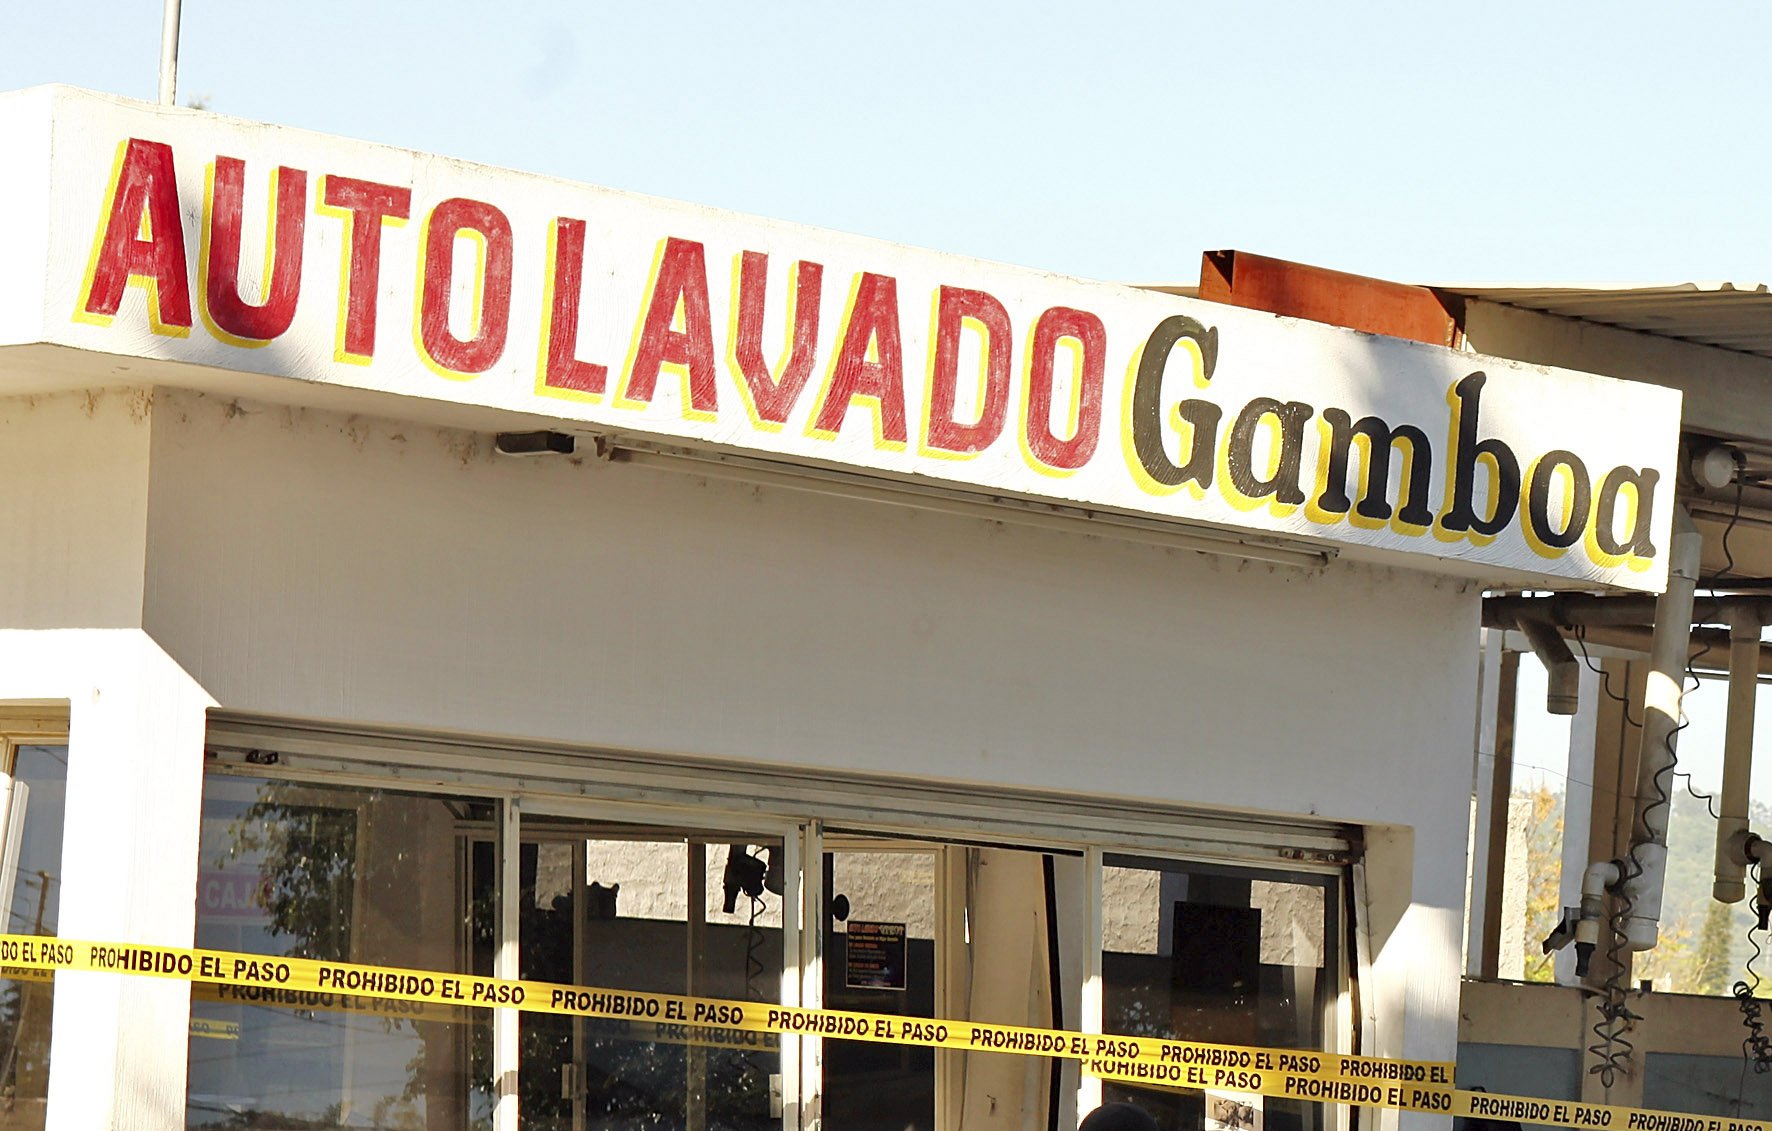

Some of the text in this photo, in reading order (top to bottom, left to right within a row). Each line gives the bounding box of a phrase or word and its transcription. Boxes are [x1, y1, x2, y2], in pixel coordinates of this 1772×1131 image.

[1124, 314, 1661, 571] Gamboa
[206, 880, 266, 909] CAJ
[22, 941, 37, 962] EL
[41, 943, 73, 965] PASO
[90, 946, 193, 974] PROHIBIDO
[200, 956, 226, 978] EL
[233, 959, 291, 983] PASO
[318, 967, 434, 997] PROHIBIDO
[441, 979, 465, 1000] EL
[472, 982, 525, 1005] PASO
[551, 989, 660, 1017] PROHIBIDO
[664, 1000, 687, 1021] EL
[693, 1003, 744, 1025] PASO
[767, 1010, 869, 1036] PROHIBIDO
[874, 1020, 895, 1039] EL
[900, 1022, 948, 1043] PASO
[970, 1028, 1066, 1053] PROHIBIDO
[1070, 1037, 1090, 1056] EL
[1096, 1039, 1140, 1059] PASO
[1160, 1044, 1250, 1069] PROHIBIDO
[1254, 1051, 1274, 1071] EL
[1278, 1054, 1321, 1074] PASO
[1340, 1059, 1426, 1082] PROHIBIDO
[1430, 1066, 1449, 1084] EL
[1187, 1067, 1208, 1085] EL
[1214, 1069, 1262, 1090] PASO
[1285, 1076, 1382, 1104] PROHIBIDO
[1387, 1088, 1407, 1107] EL
[1412, 1090, 1452, 1110] PASO
[1470, 1096, 1549, 1121] PROHIBIDO
[1553, 1105, 1570, 1123] EL
[1574, 1107, 1612, 1127] PASO
